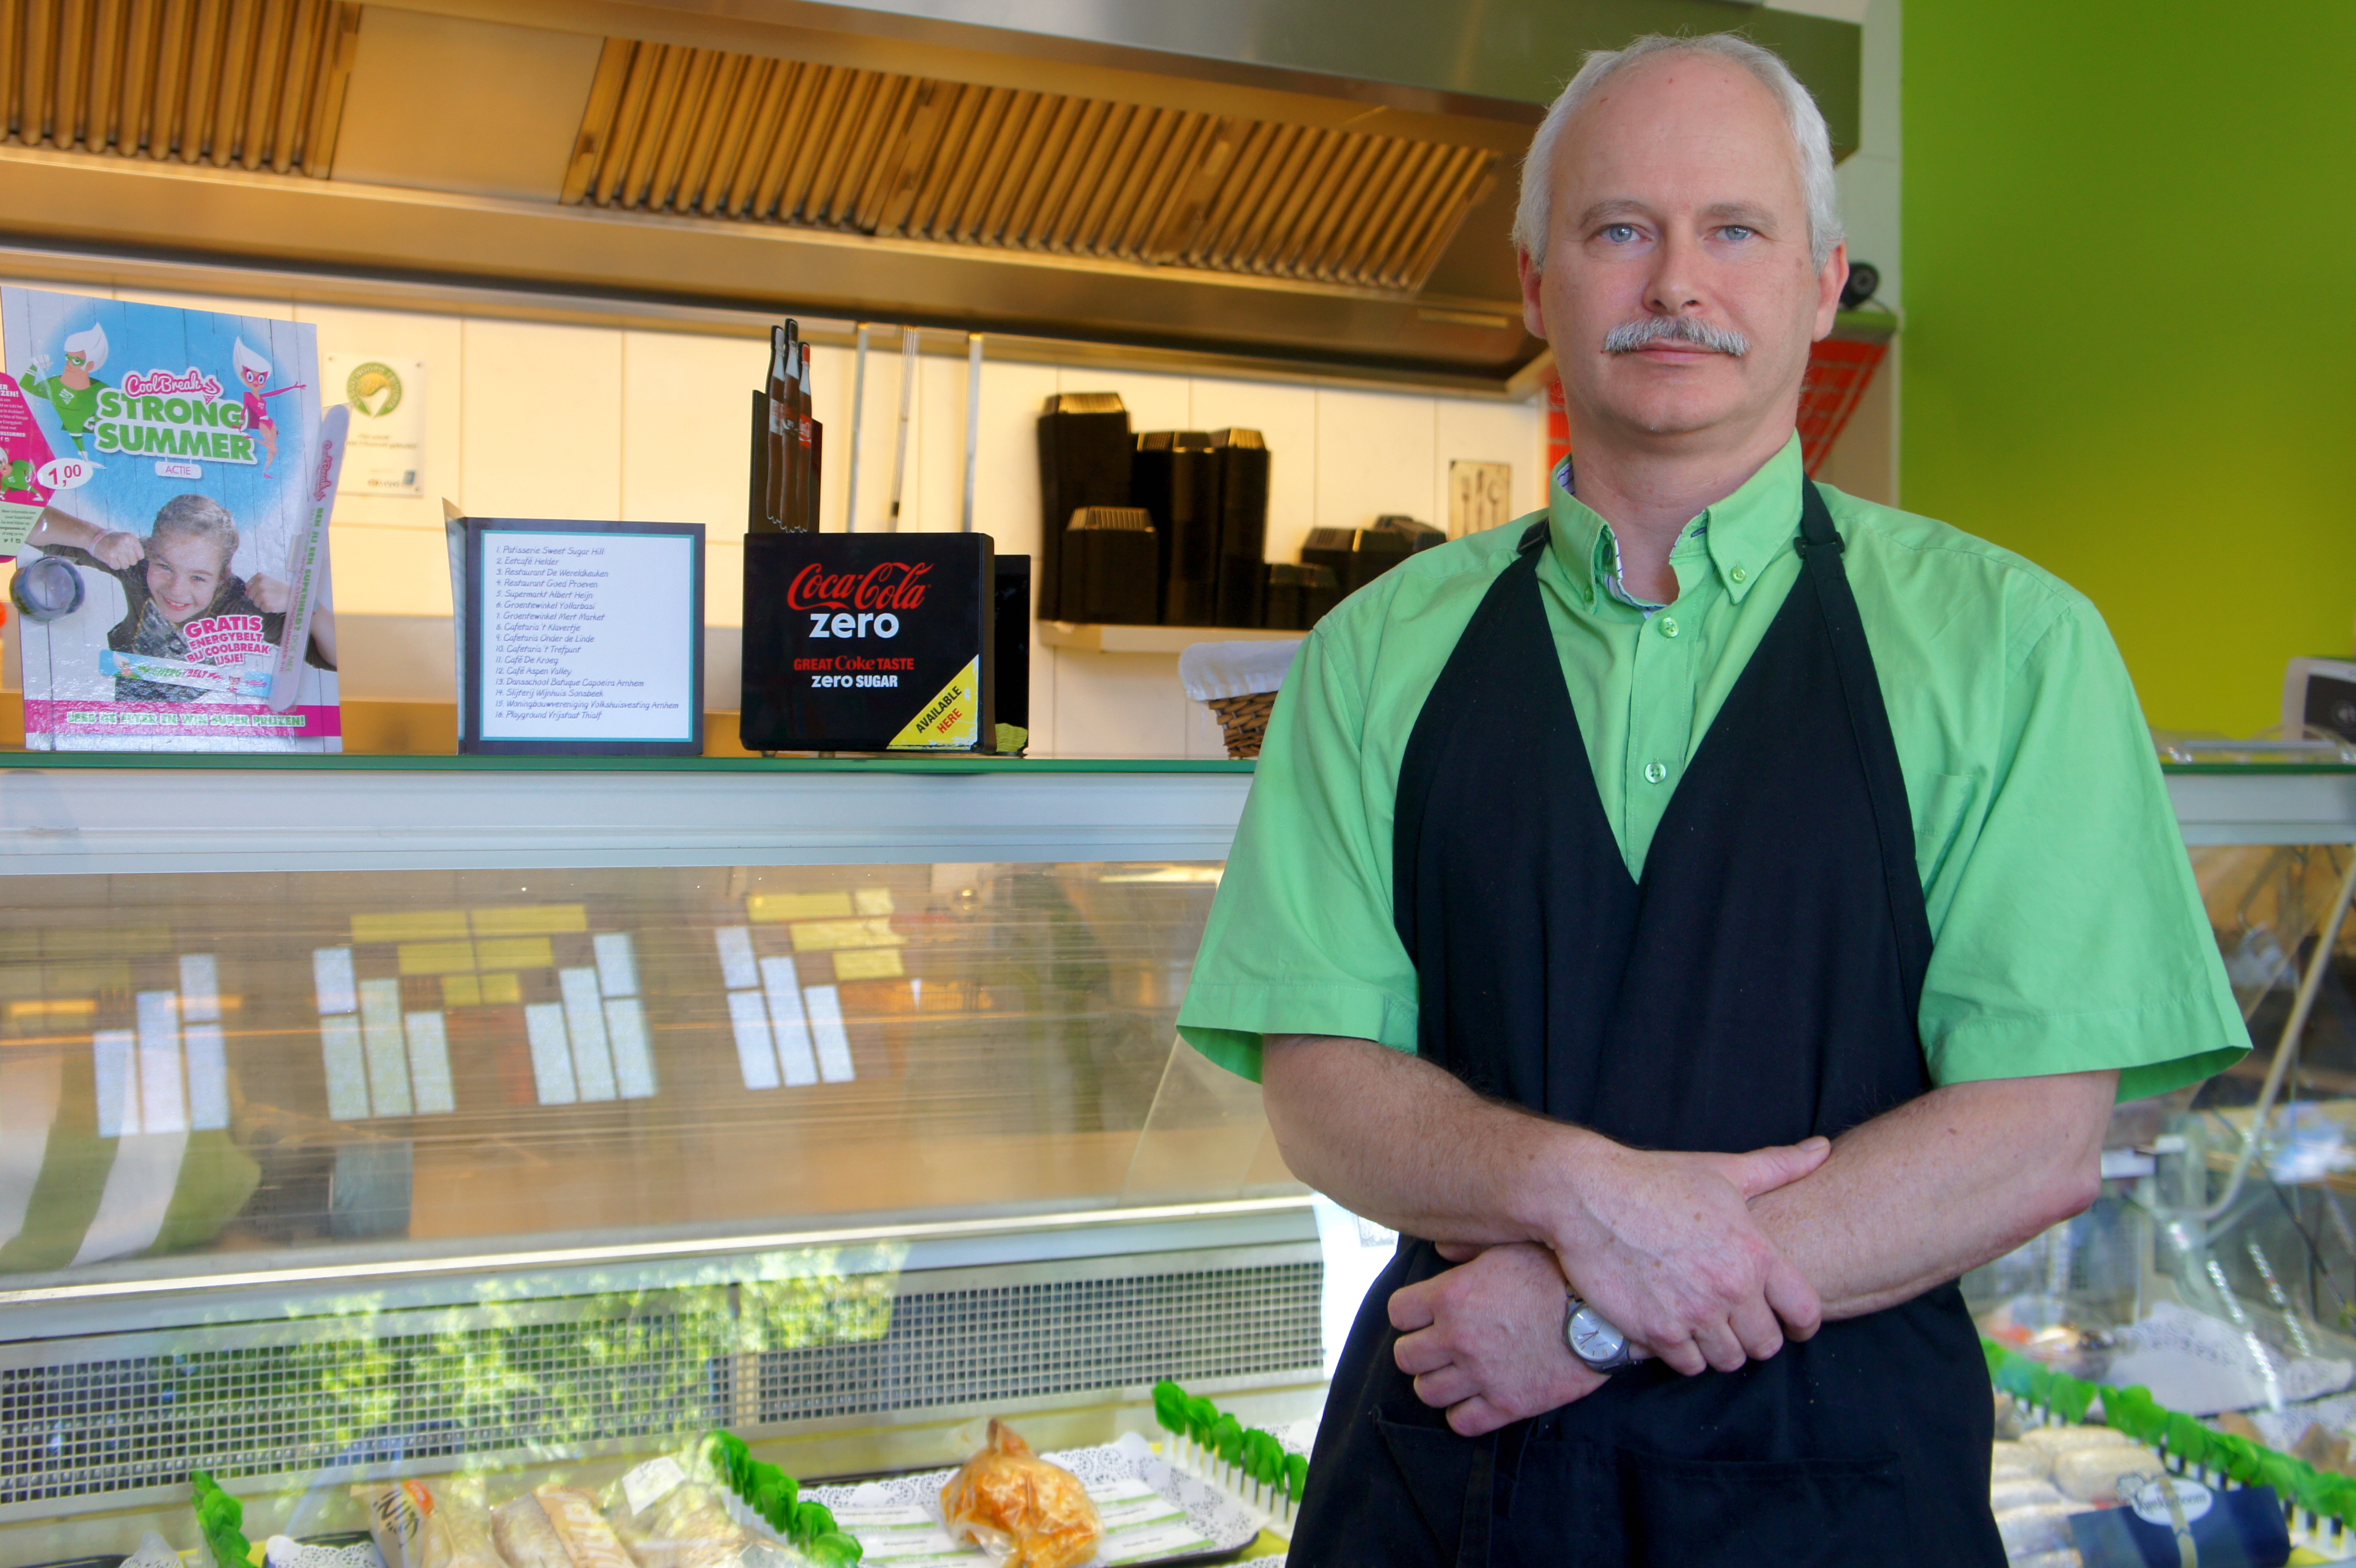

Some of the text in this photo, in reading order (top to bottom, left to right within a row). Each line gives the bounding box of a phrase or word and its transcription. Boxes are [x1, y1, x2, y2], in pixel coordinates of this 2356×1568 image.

[100, 391, 243, 428] STRONG
[98, 423, 254, 461] SUMMER
[48, 464, 82, 487] 1,00
[165, 465, 192, 476] ACTIE
[314, 507, 324, 527] BEN
[306, 547, 316, 564] EEN
[503, 546, 540, 554] Patisserie
[542, 546, 565, 555] Sweet
[567, 547, 589, 557] Sugar
[505, 556, 533, 566] Eetcafé
[559, 569, 608, 578] Wereldkeuken
[787, 562, 935, 610] Coca-Cola
[294, 568, 312, 631] SUPERHELD?
[505, 590, 547, 599] Supermarkt
[574, 591, 593, 602] Heijn
[504, 601, 558, 610] Groentewinkel
[559, 602, 595, 610] Yollarbasi
[503, 611, 556, 620] Groentewinkel
[185, 616, 261, 638] GRATIS
[504, 623, 539, 632] Cafetaria
[547, 623, 580, 634] Klavertje
[809, 612, 900, 639] zero
[189, 632, 262, 649] ENERGYBELT
[290, 635, 299, 653] DOE
[503, 634, 538, 643] Cafetaria
[186, 643, 270, 663] BIJ COOLBREAK
[506, 645, 542, 654] Cafetaria
[550, 645, 582, 656] Trefpunt
[215, 653, 243, 665] IJSJE!
[285, 656, 294, 672] MEE
[505, 656, 523, 665] Café
[536, 657, 559, 666] Kroeg
[794, 655, 915, 671] GREAT Coke TASTE
[506, 667, 525, 676] Café
[526, 668, 548, 677] Aspen
[550, 668, 572, 677] Valley
[550, 679, 581, 689] Batuque
[582, 679, 614, 689] Capoeira
[811, 675, 898, 688] zero SUGAR
[506, 688, 534, 699] Slijterij
[536, 689, 566, 699] Wijnhuis
[506, 699, 588, 709] Woningbouwvereniging
[591, 700, 649, 710] Volkshuisvesting
[915, 685, 962, 734] AVAILABLE
[179, 714, 208, 725] WIN
[210, 714, 250, 726] SUPER
[252, 715, 305, 727] PRIJZEN!
[506, 710, 546, 720] Playground
[549, 711, 580, 721] Vrijstaat
[581, 711, 602, 721] Thialf
[936, 708, 963, 734] HERE
